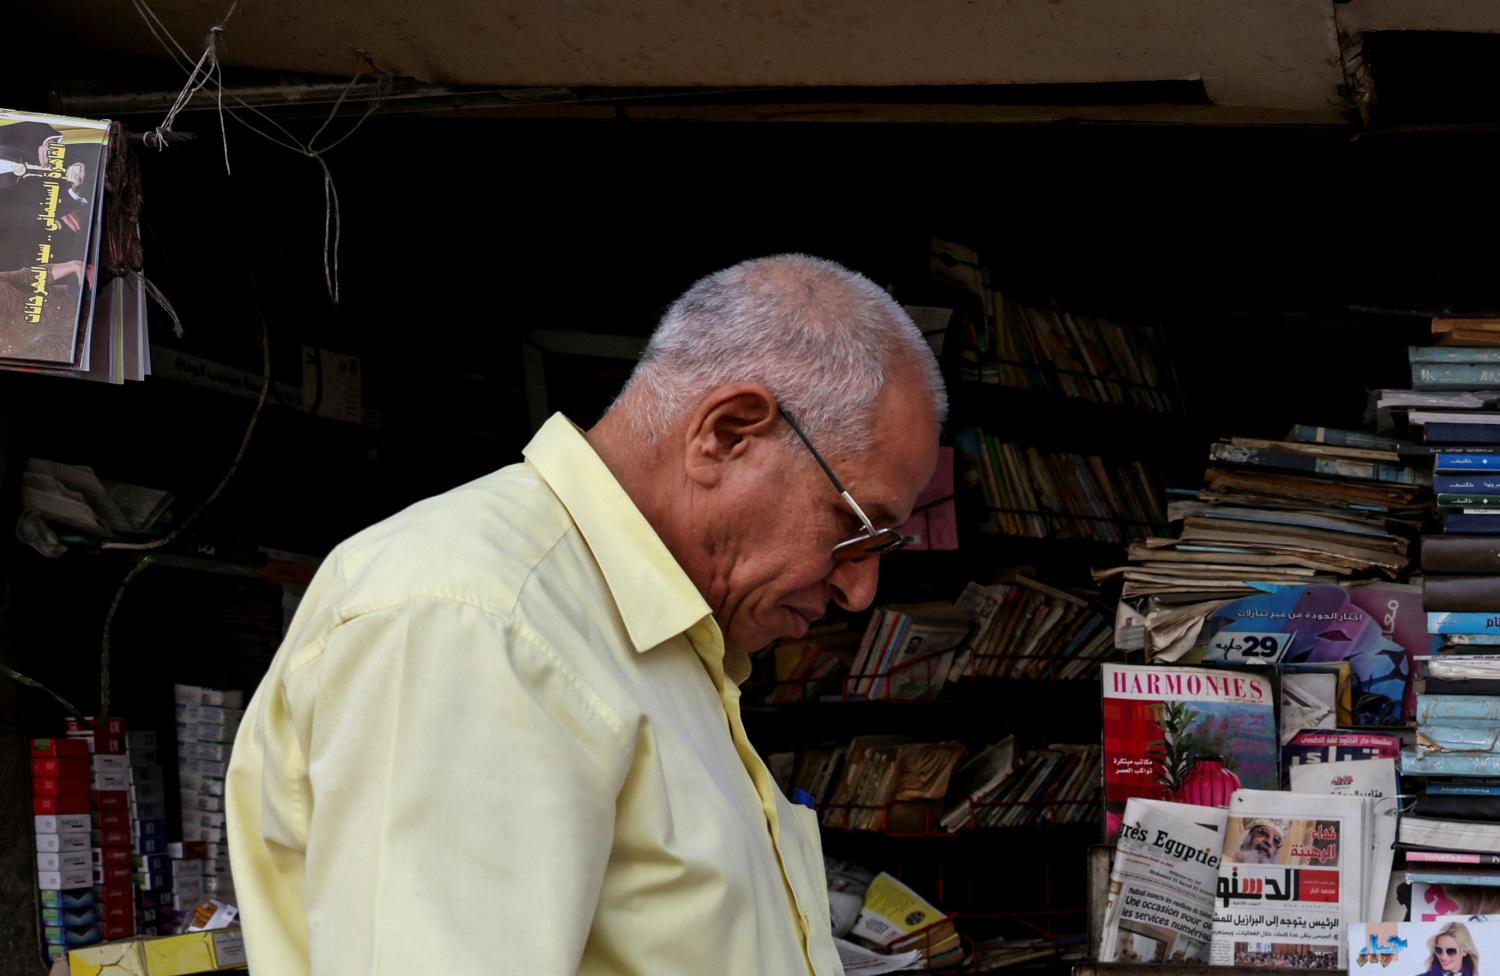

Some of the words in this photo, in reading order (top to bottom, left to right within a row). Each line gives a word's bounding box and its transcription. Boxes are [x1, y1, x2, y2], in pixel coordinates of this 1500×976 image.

[34, 243, 55, 265] سيد
[23, 266, 48, 323] المهرجانات
[1236, 610, 1268, 618] تنازلات
[1269, 611, 1285, 619] غير
[1305, 613, 1337, 621] الجودة
[1340, 614, 1362, 622] اختار
[1242, 636, 1278, 657] 29
[1112, 672, 1263, 700] HARMONIES
[1312, 826, 1336, 840] نداء
[1291, 844, 1336, 864] الرهينة
[1216, 866, 1300, 908] الدستو
[1124, 895, 1141, 908] Une
[1140, 899, 1180, 919] occasion
[1234, 914, 1264, 926] البرازيل
[1265, 915, 1279, 928] إلى
[1280, 916, 1307, 928] يتوجه
[1309, 918, 1339, 929] الرئيس
